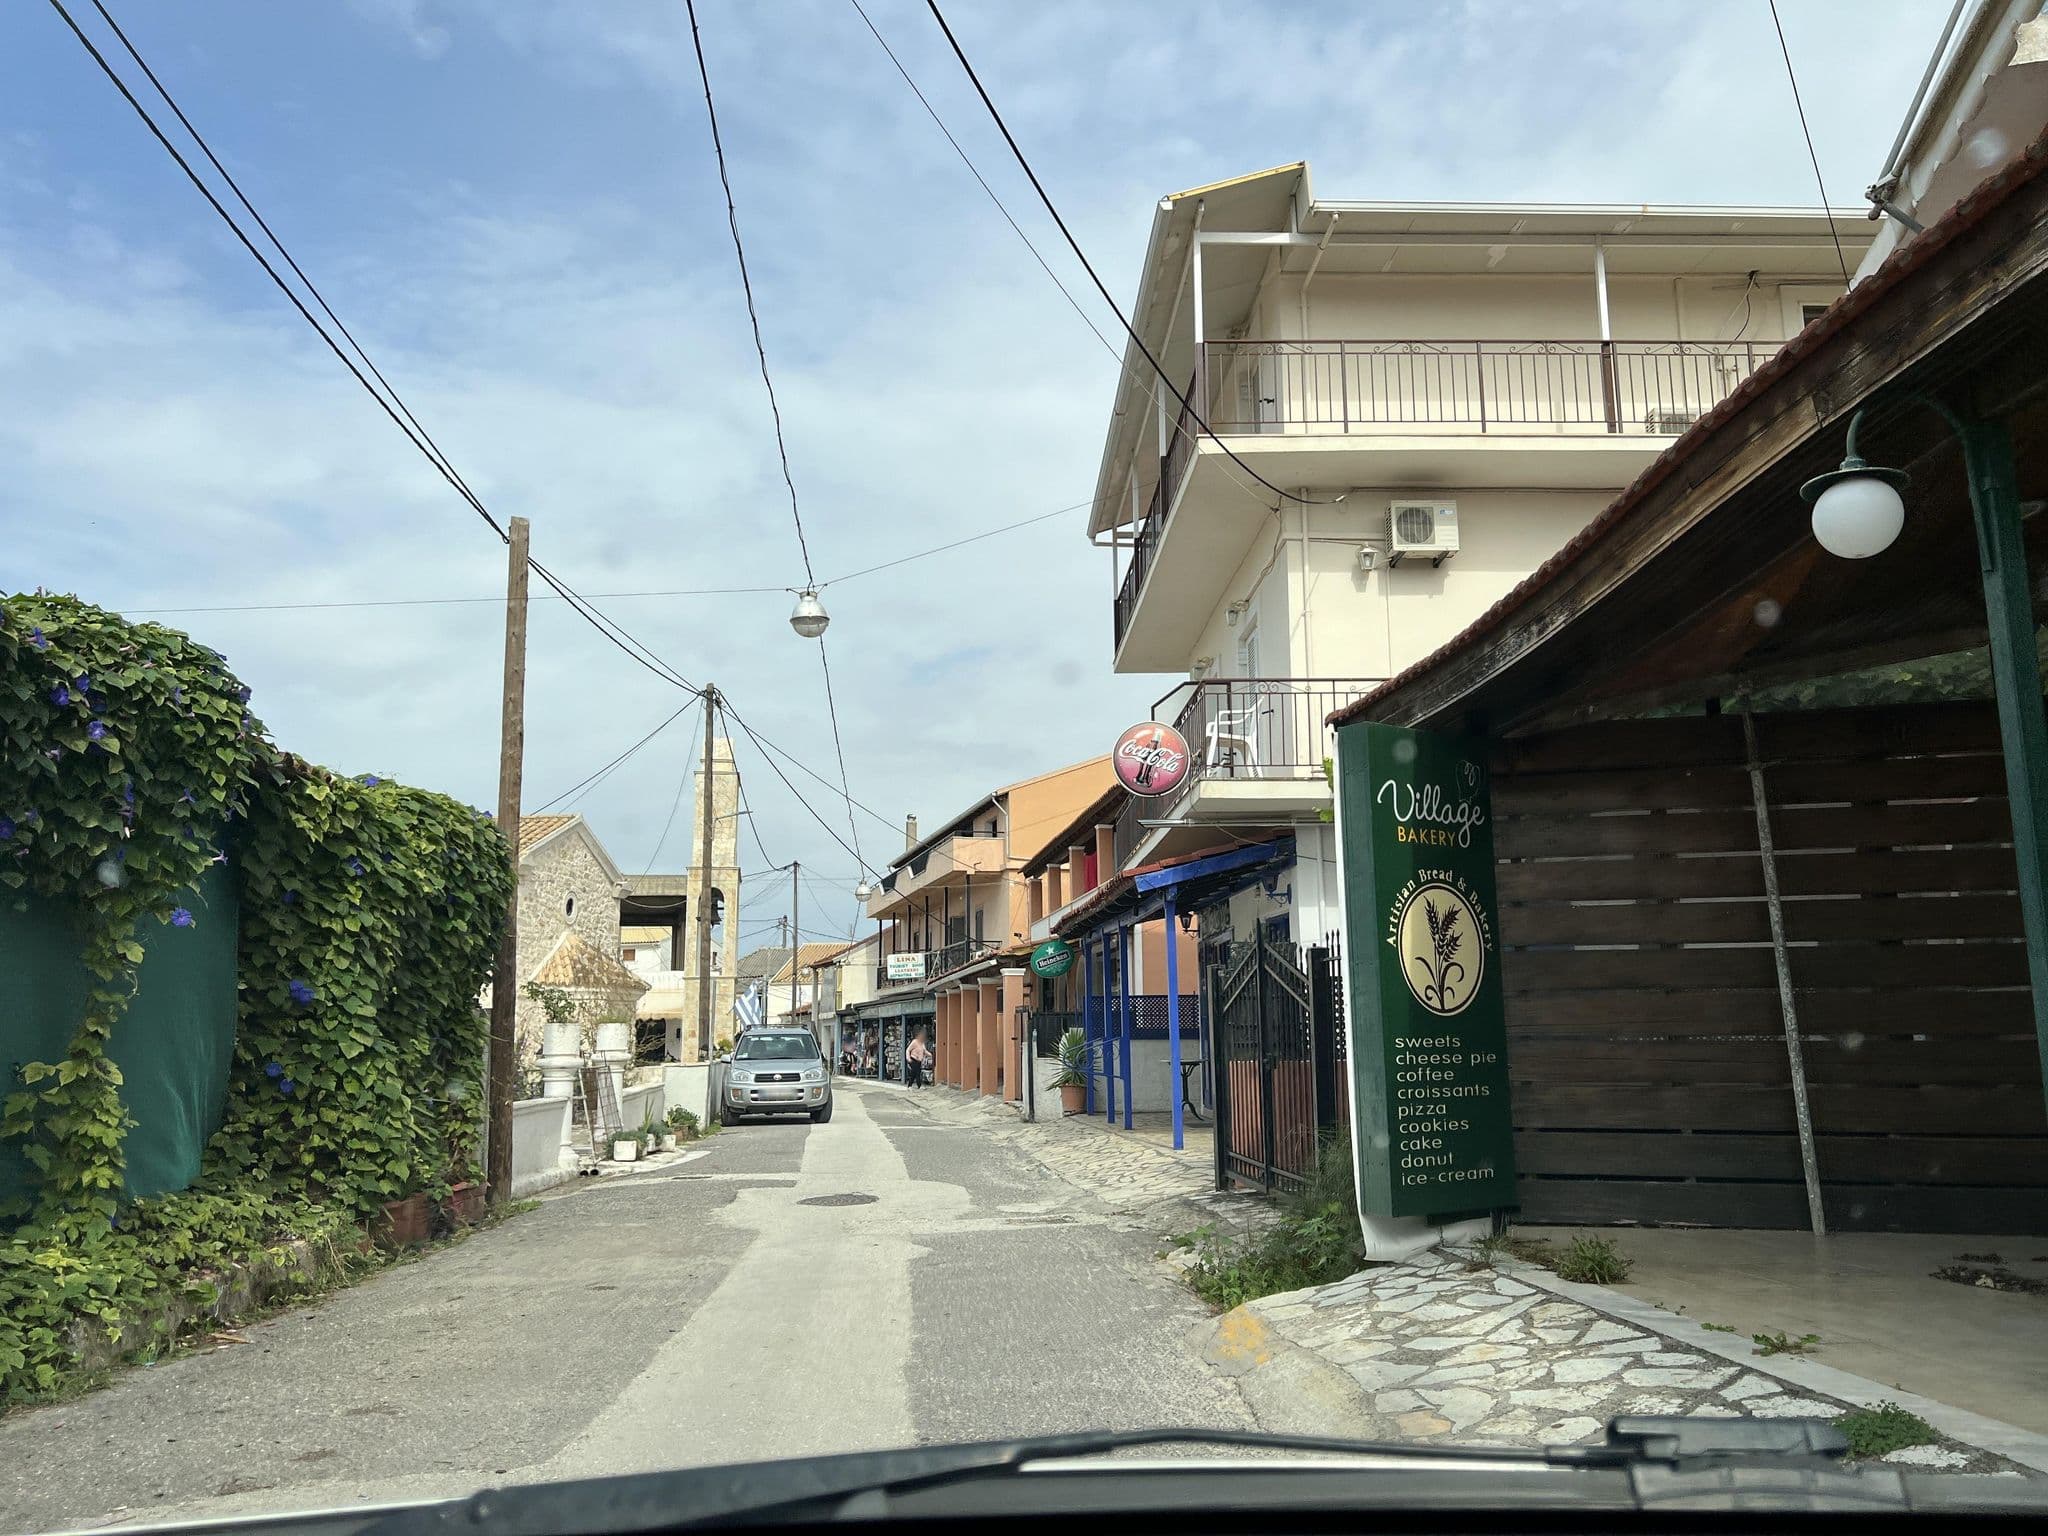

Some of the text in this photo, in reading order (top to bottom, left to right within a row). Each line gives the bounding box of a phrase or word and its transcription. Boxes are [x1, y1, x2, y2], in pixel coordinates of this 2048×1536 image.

[1377, 780, 1485, 848] Village
[1397, 826, 1456, 847] BAKERY
[1386, 869, 1493, 952] Artisian Bread & Bakery
[1039, 953, 1068, 967] Heineken
[1395, 1035, 1461, 1048] sweets
[1396, 1051, 1497, 1067] cheese pie
[1397, 1067, 1454, 1082] coffee
[1397, 1084, 1490, 1099] croissants
[1398, 1103, 1447, 1120] pizza
[1399, 1118, 1469, 1134] cookies
[1400, 1135, 1442, 1151] cake
[1401, 1152, 1453, 1168] donut
[1402, 1168, 1494, 1186] ice-cream
